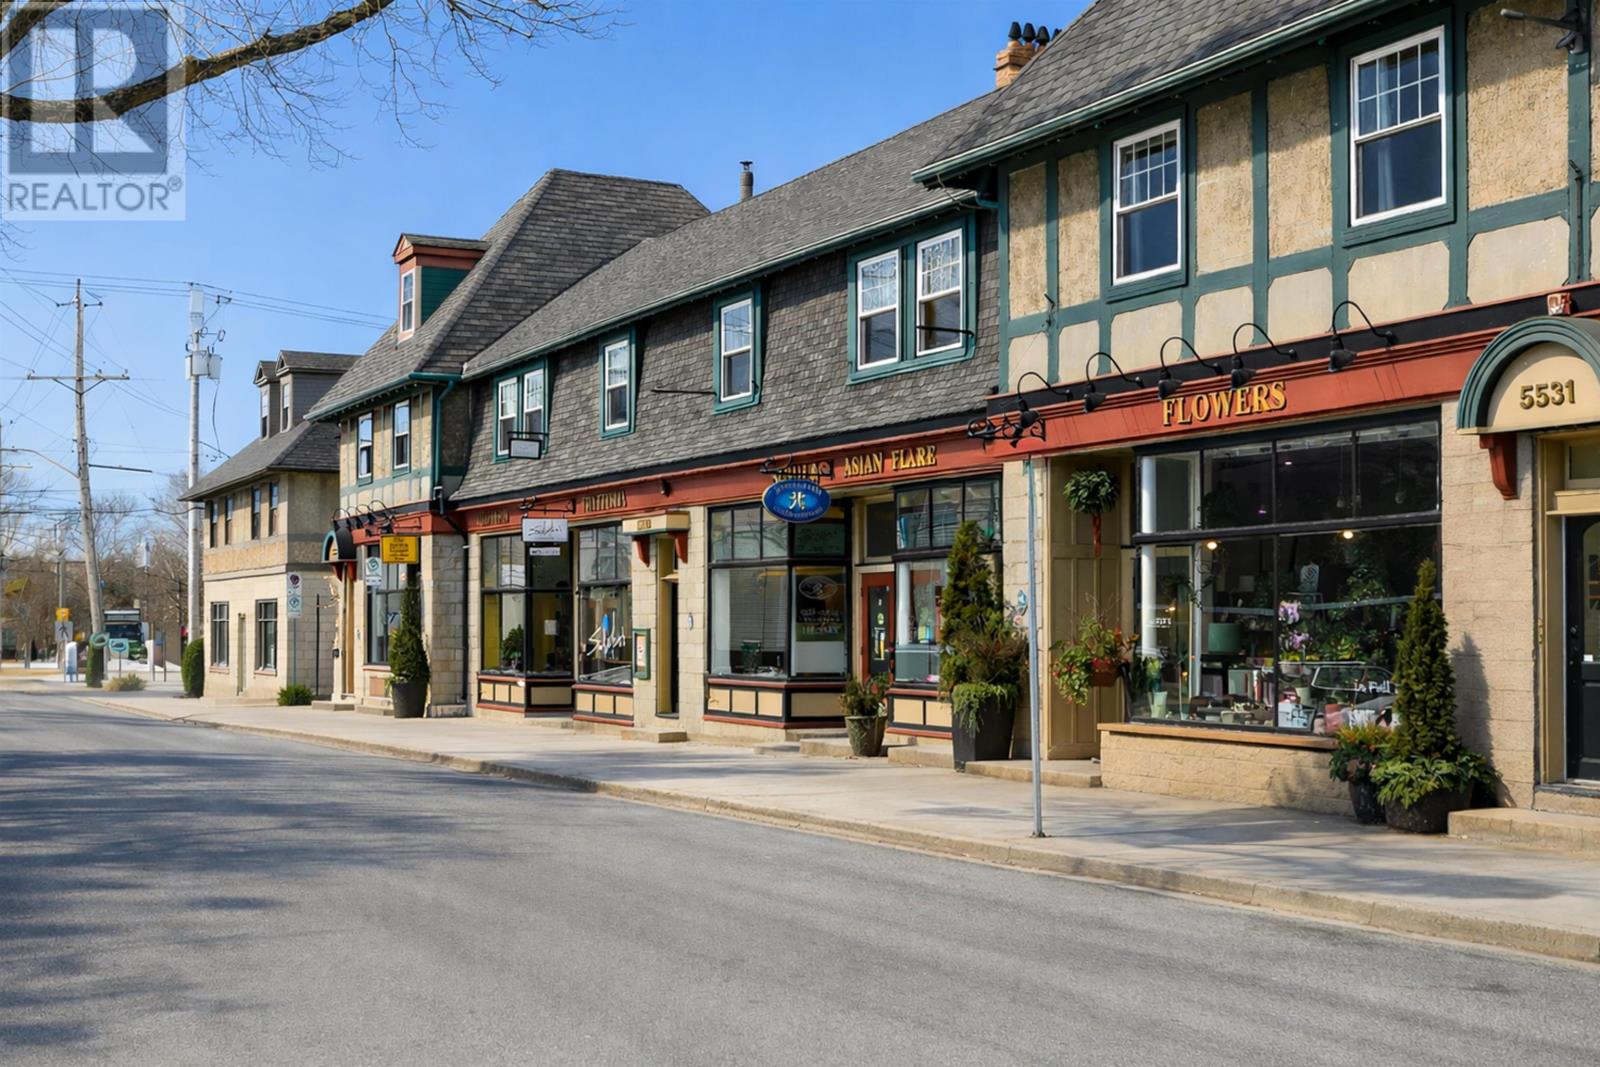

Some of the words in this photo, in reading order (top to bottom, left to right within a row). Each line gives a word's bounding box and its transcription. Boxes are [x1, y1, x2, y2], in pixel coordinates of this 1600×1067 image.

[1162, 381, 1287, 426] FLOWERS
[1519, 379, 1576, 410] 5531
[843, 452, 885, 478] ASIAN
[891, 445, 938, 472] FLARE
